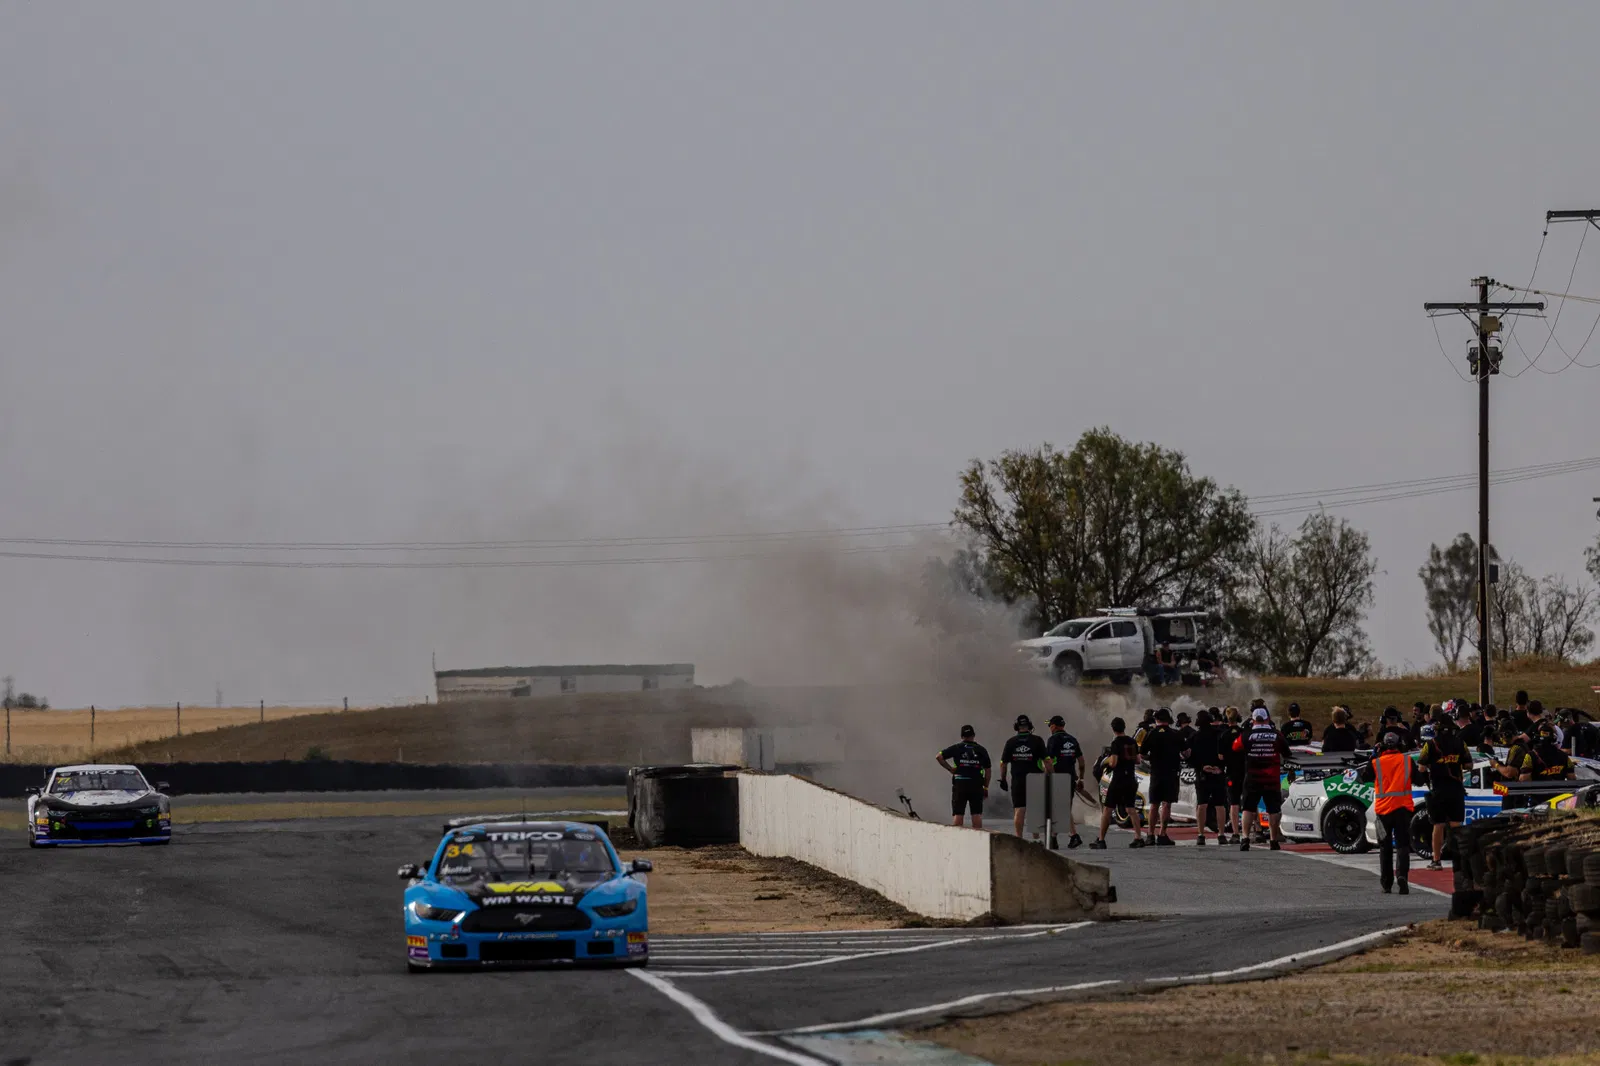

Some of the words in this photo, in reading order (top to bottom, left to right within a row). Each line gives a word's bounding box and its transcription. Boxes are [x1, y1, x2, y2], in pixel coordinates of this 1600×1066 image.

[486, 832, 564, 841] TRICO
[447, 843, 474, 858] 34
[482, 896, 512, 907] WM
[515, 894, 575, 905] WASTE
